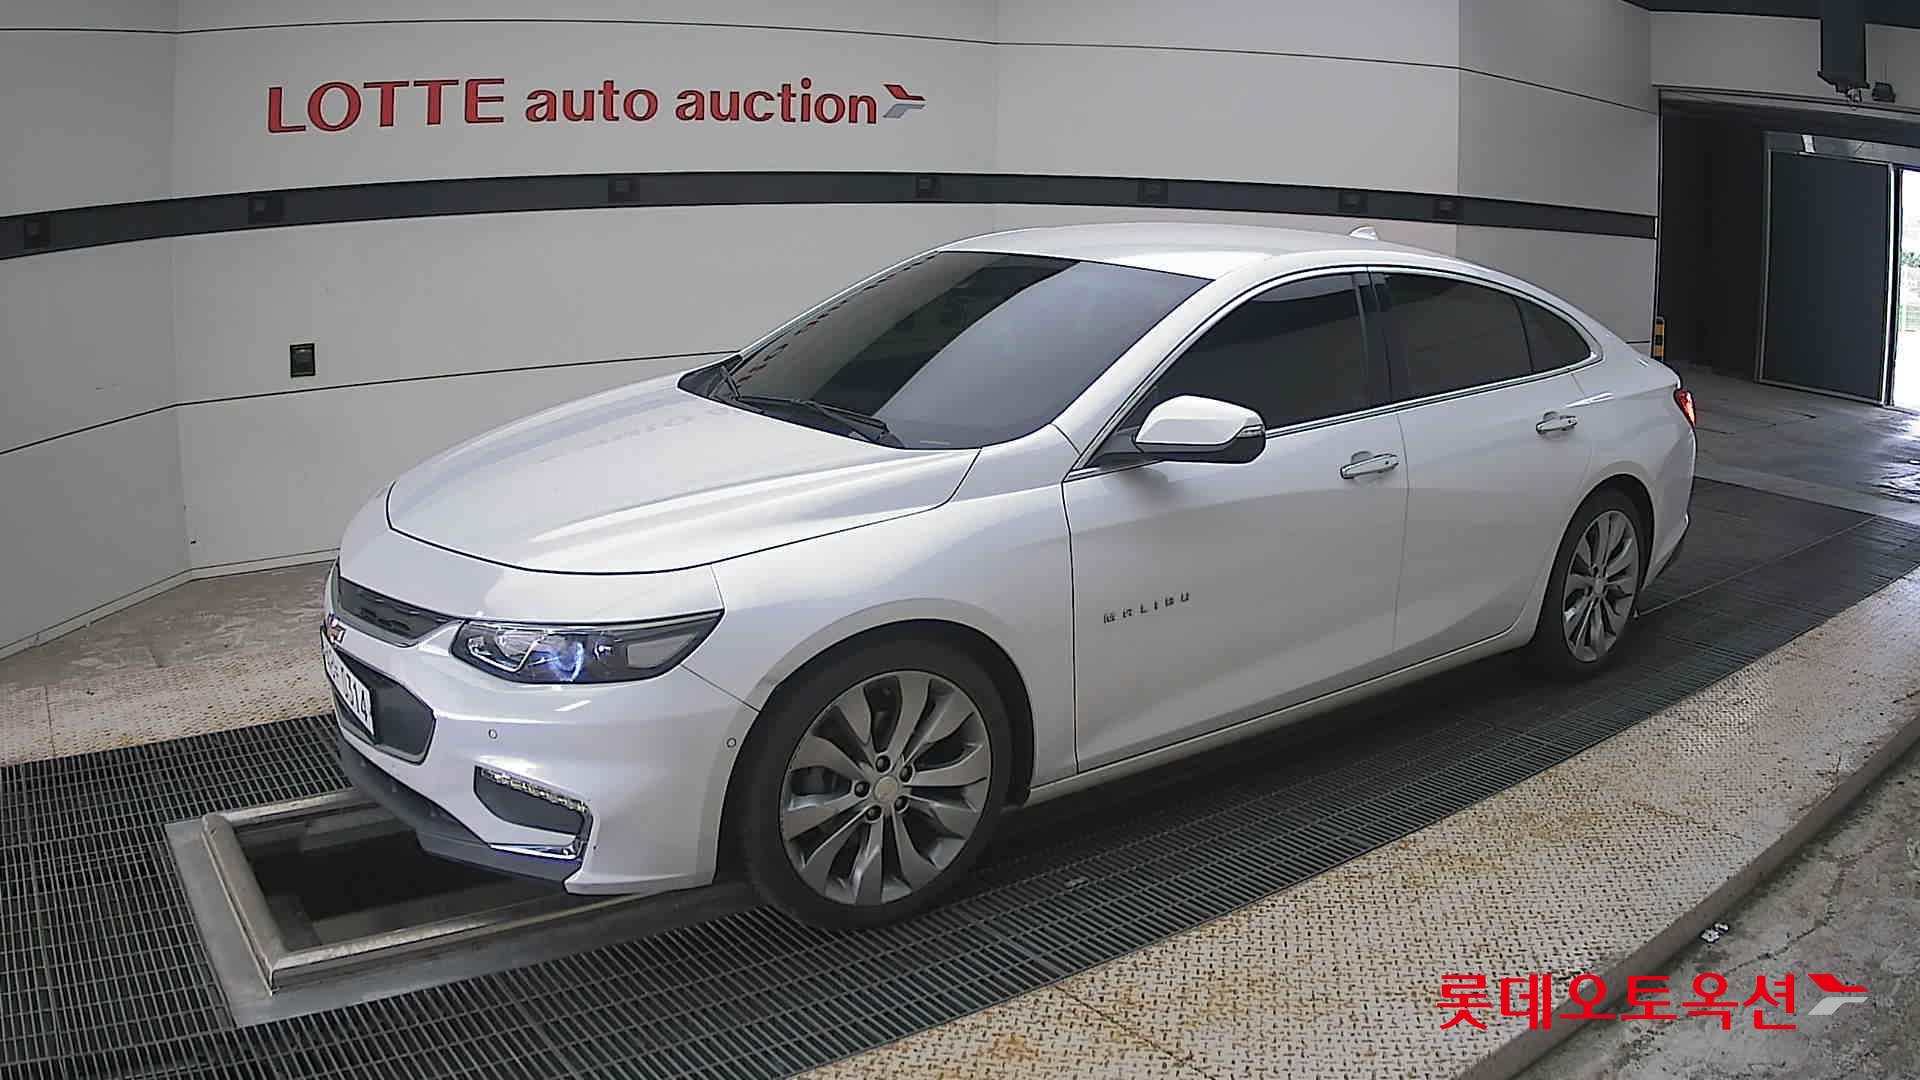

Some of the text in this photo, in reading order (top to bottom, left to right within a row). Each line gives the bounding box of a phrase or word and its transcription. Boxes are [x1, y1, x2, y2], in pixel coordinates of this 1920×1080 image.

[268, 77, 878, 133] LOTTE auto auction
